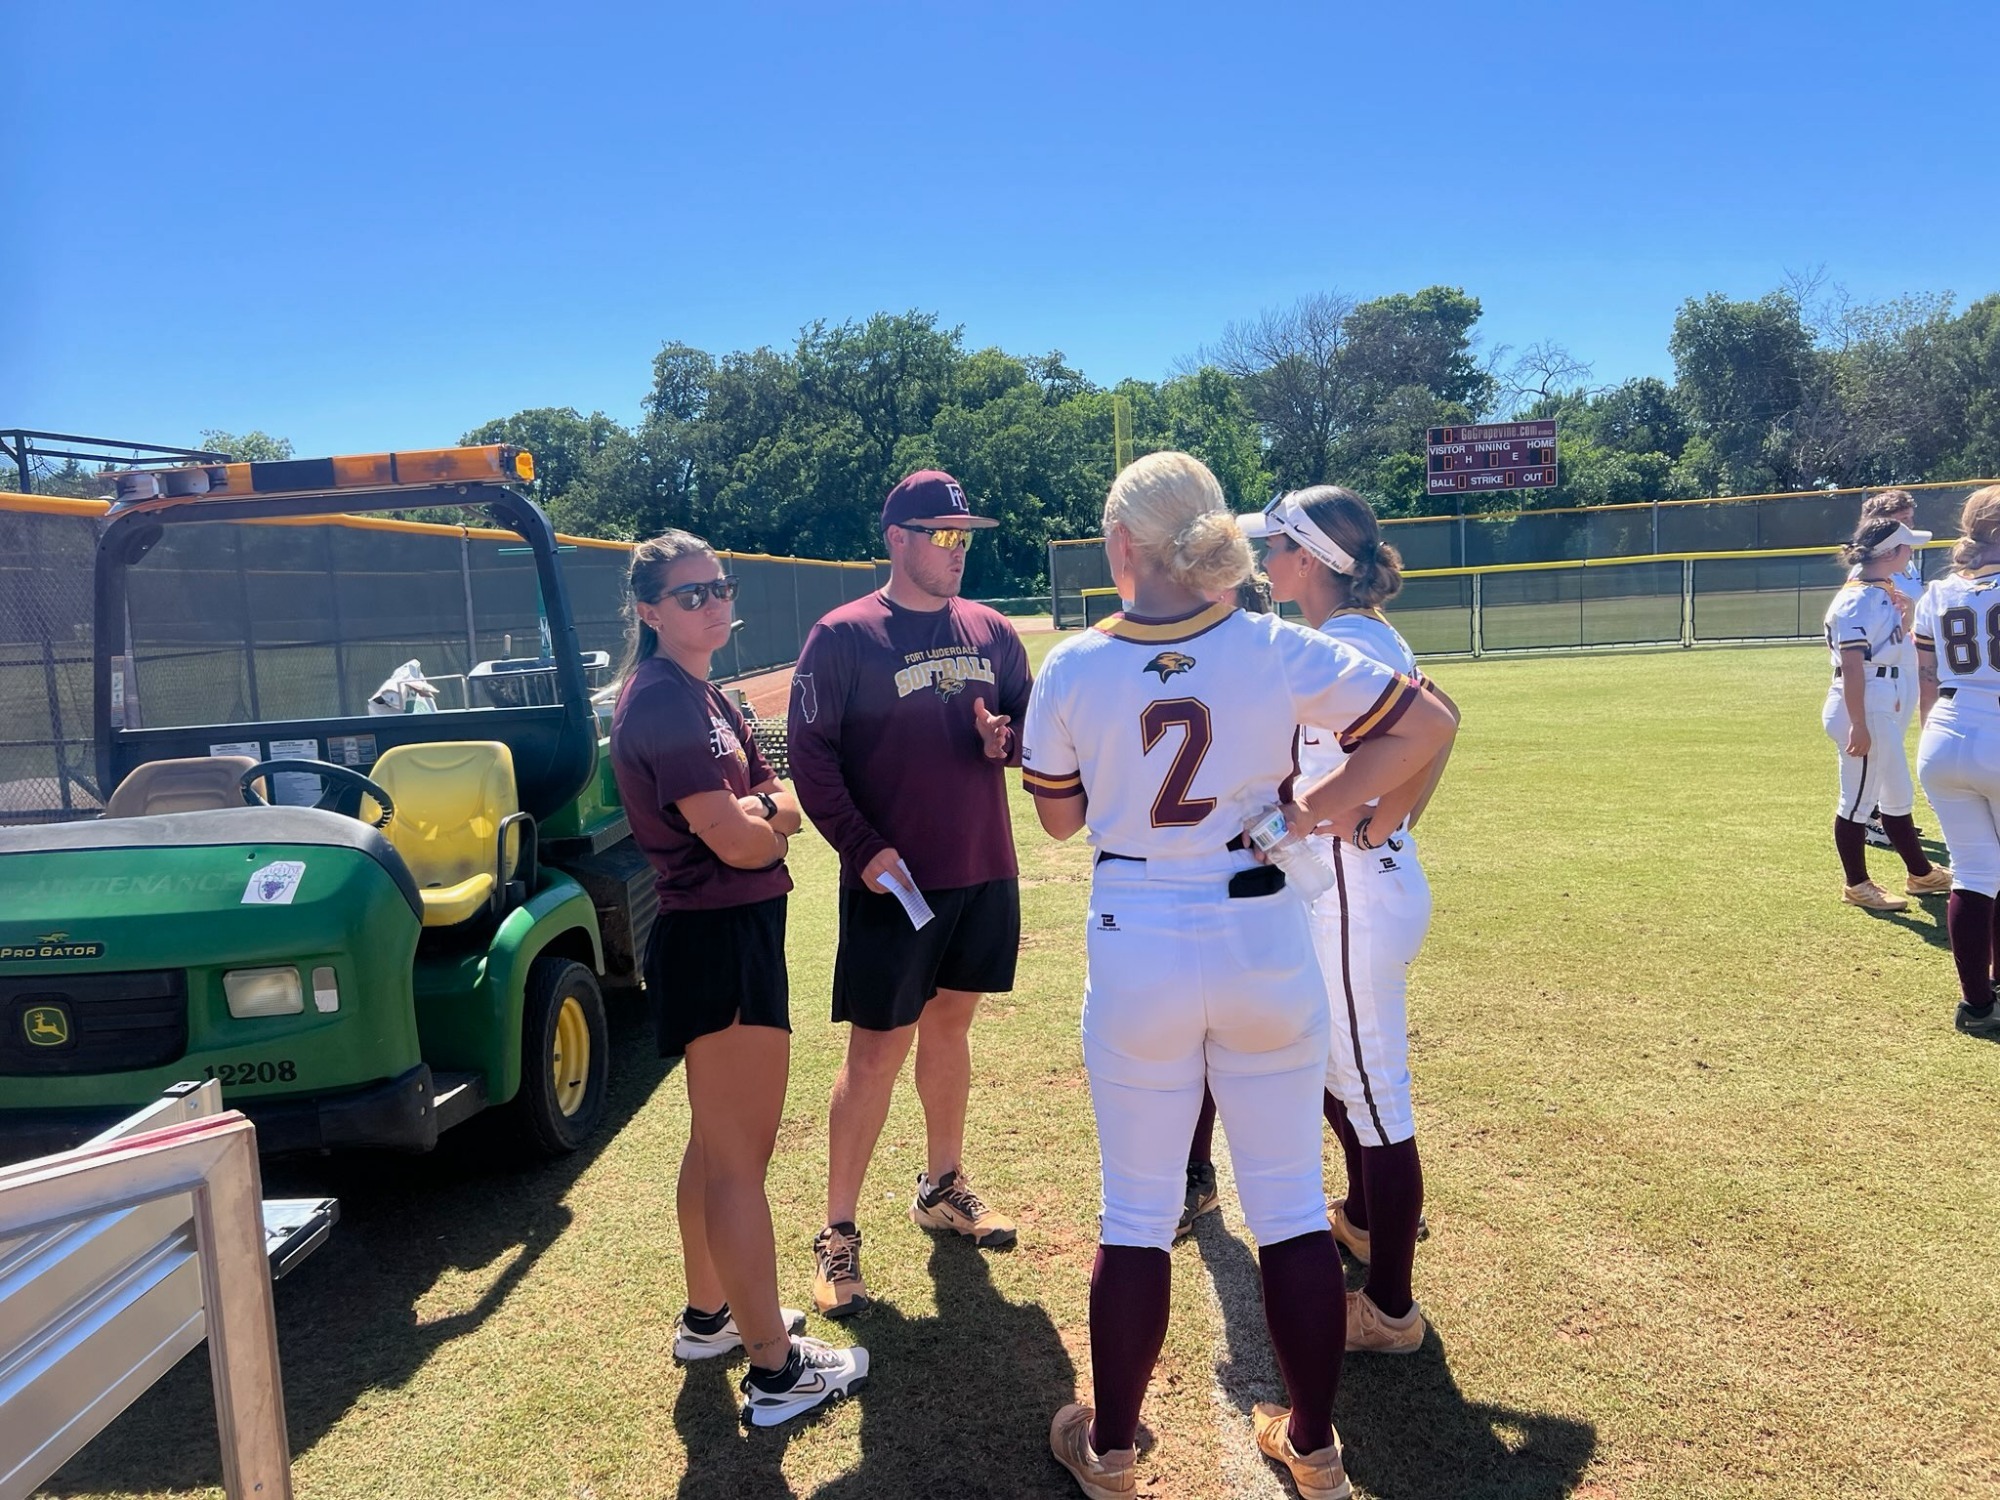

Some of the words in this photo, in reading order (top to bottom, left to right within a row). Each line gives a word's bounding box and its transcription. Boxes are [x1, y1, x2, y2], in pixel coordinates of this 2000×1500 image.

[1475, 442, 1511, 452] INNING
[1526, 439, 1555, 449] HOME
[1429, 445, 1466, 455] VISITOR
[1465, 455, 1472, 463] H
[1512, 452, 1519, 461] E
[1470, 475, 1504, 485] STRIKE
[1523, 472, 1543, 482] OUT
[1431, 479, 1455, 487] BALL
[904, 650, 925, 664] FORT
[926, 646, 979, 659] LUDERDALE
[894, 656, 995, 698] SOFTBALL
[1140, 697, 1216, 828] 2
[0, 948, 36, 958] PRO
[40, 946, 97, 957] GATOR
[204, 1060, 298, 1086] 12208
